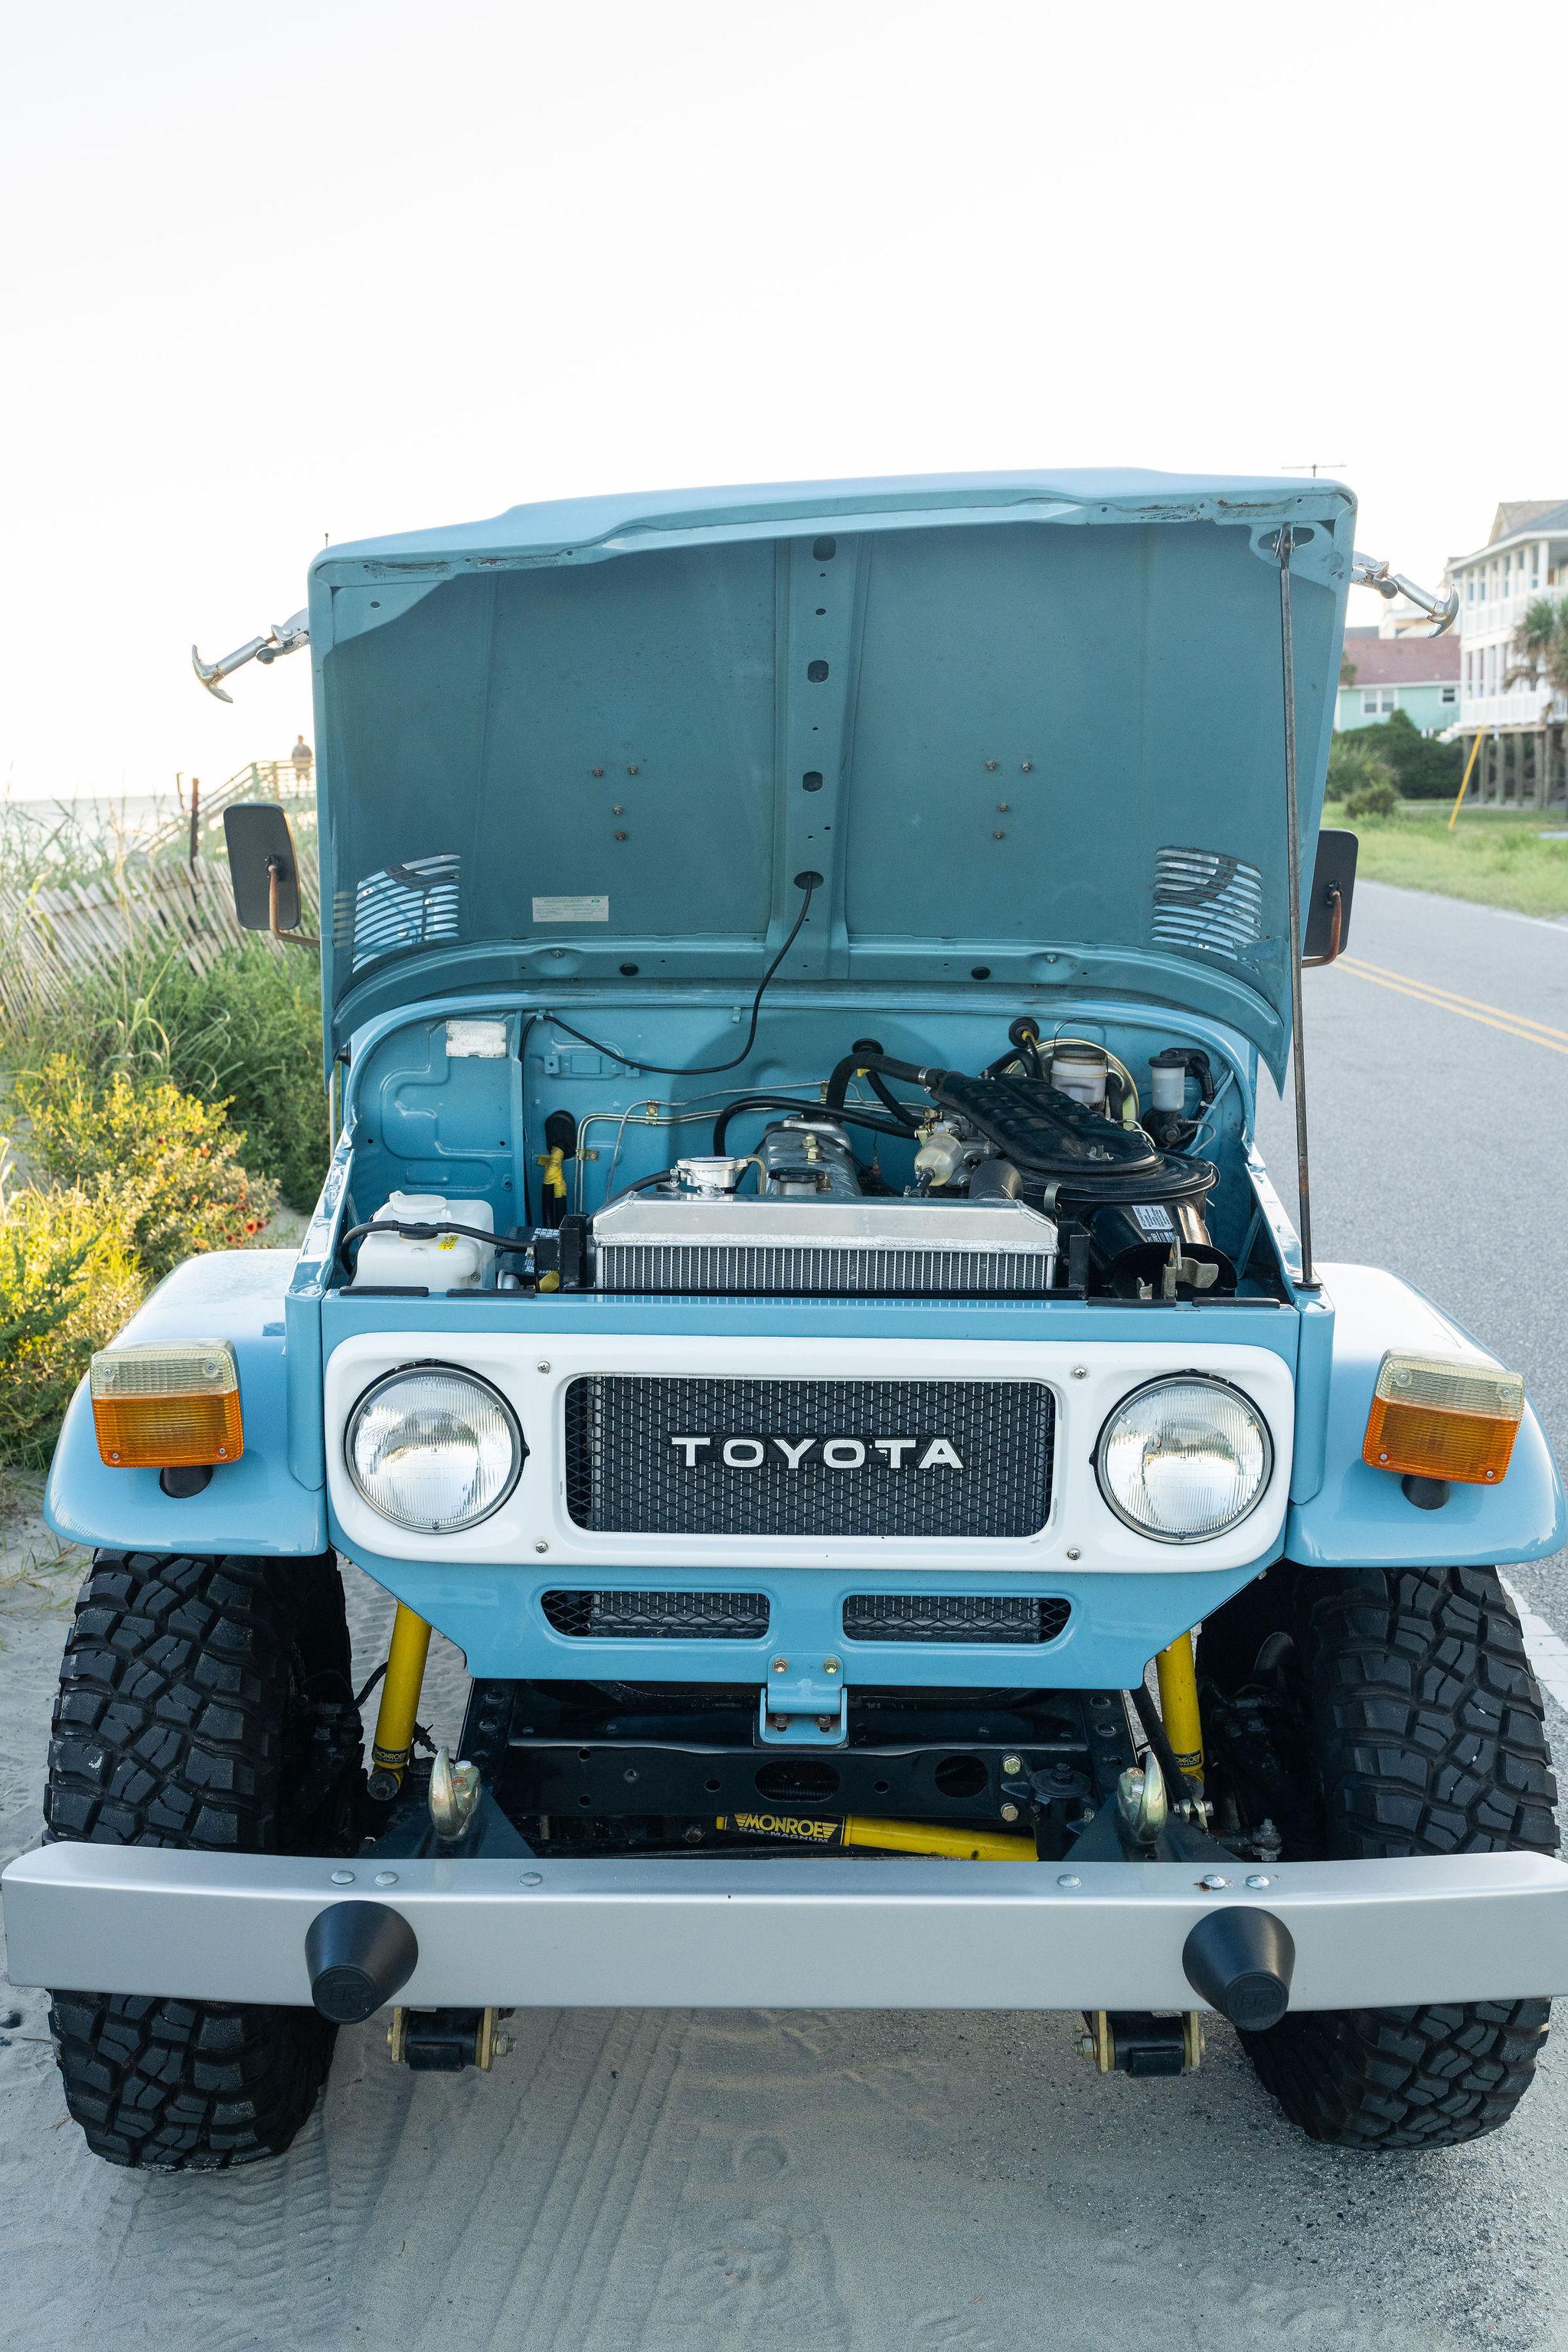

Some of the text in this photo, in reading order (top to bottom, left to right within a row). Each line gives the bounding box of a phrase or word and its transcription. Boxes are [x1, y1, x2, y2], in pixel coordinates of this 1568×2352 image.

[671, 1437, 965, 1469] TOYOTA
[1175, 1754, 1199, 1763] ONROE
[738, 1827, 828, 1843] GAS-MAGNUM
[743, 1813, 825, 1838] MONROE
